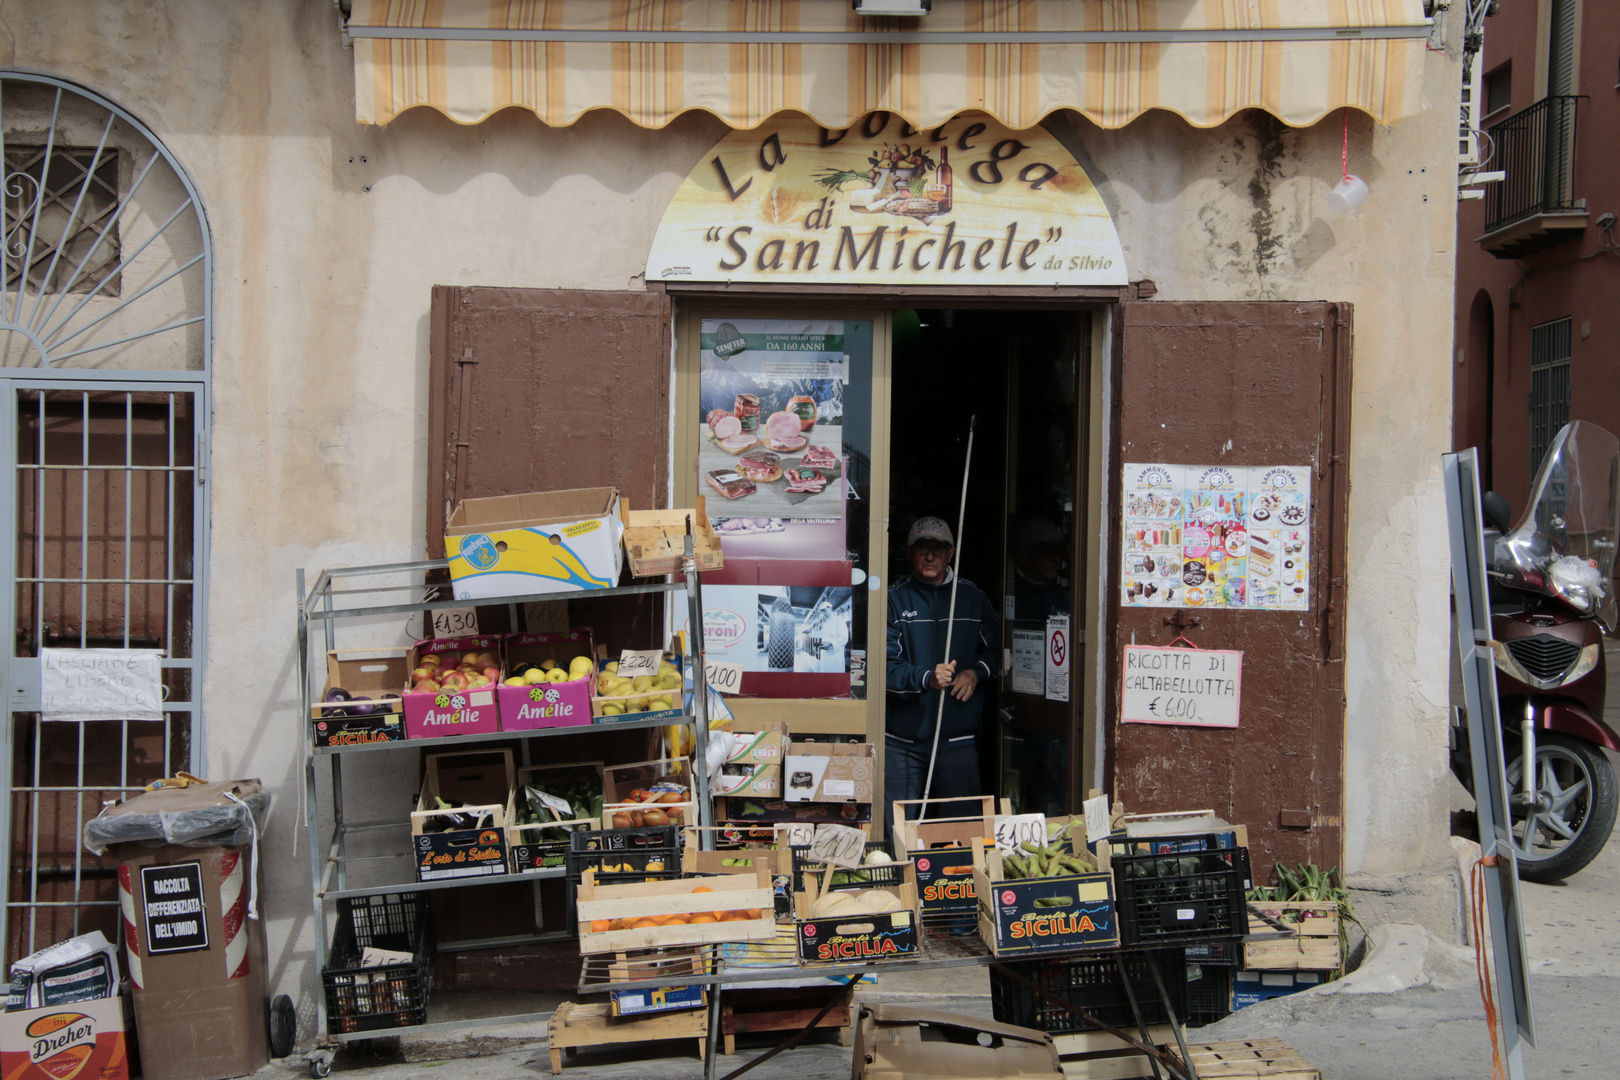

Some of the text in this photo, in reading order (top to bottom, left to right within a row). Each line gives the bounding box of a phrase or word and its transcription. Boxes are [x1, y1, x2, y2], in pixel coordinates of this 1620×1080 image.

[712, 110, 1059, 202] La oega
[804, 196, 833, 231] di
[1043, 254, 1114, 272] da Silvio
[715, 338, 746, 354] SENFTER
[766, 342, 826, 351] DA 160 ANNI
[1137, 466, 1173, 484] SAMMONTANA
[1199, 466, 1235, 484] SAMMONTANA
[1261, 467, 1297, 485] SAMMONTANA
[461, 533, 490, 558] Chiquita
[702, 623, 738, 637] eroni
[430, 641, 459, 652] Amélie
[520, 634, 549, 645] Amélie
[1125, 675, 1235, 697] CALTABELLOTTA
[422, 708, 480, 726] Amélie
[516, 702, 574, 721] Amélie
[328, 732, 390, 746] SICILIA
[421, 847, 502, 866] L'orto di Sicilia
[153, 876, 191, 895] RACCOLTA
[924, 883, 977, 900] SICIL
[147, 898, 202, 918] DIFFERENZIATA
[1020, 911, 1068, 922] Bontà
[154, 919, 199, 940] DELL'UMIDO
[1009, 915, 1095, 938] SICILIA
[817, 938, 898, 959] SICILIA
[827, 934, 871, 945] Bontà
[32, 1023, 93, 1060] Dreher
